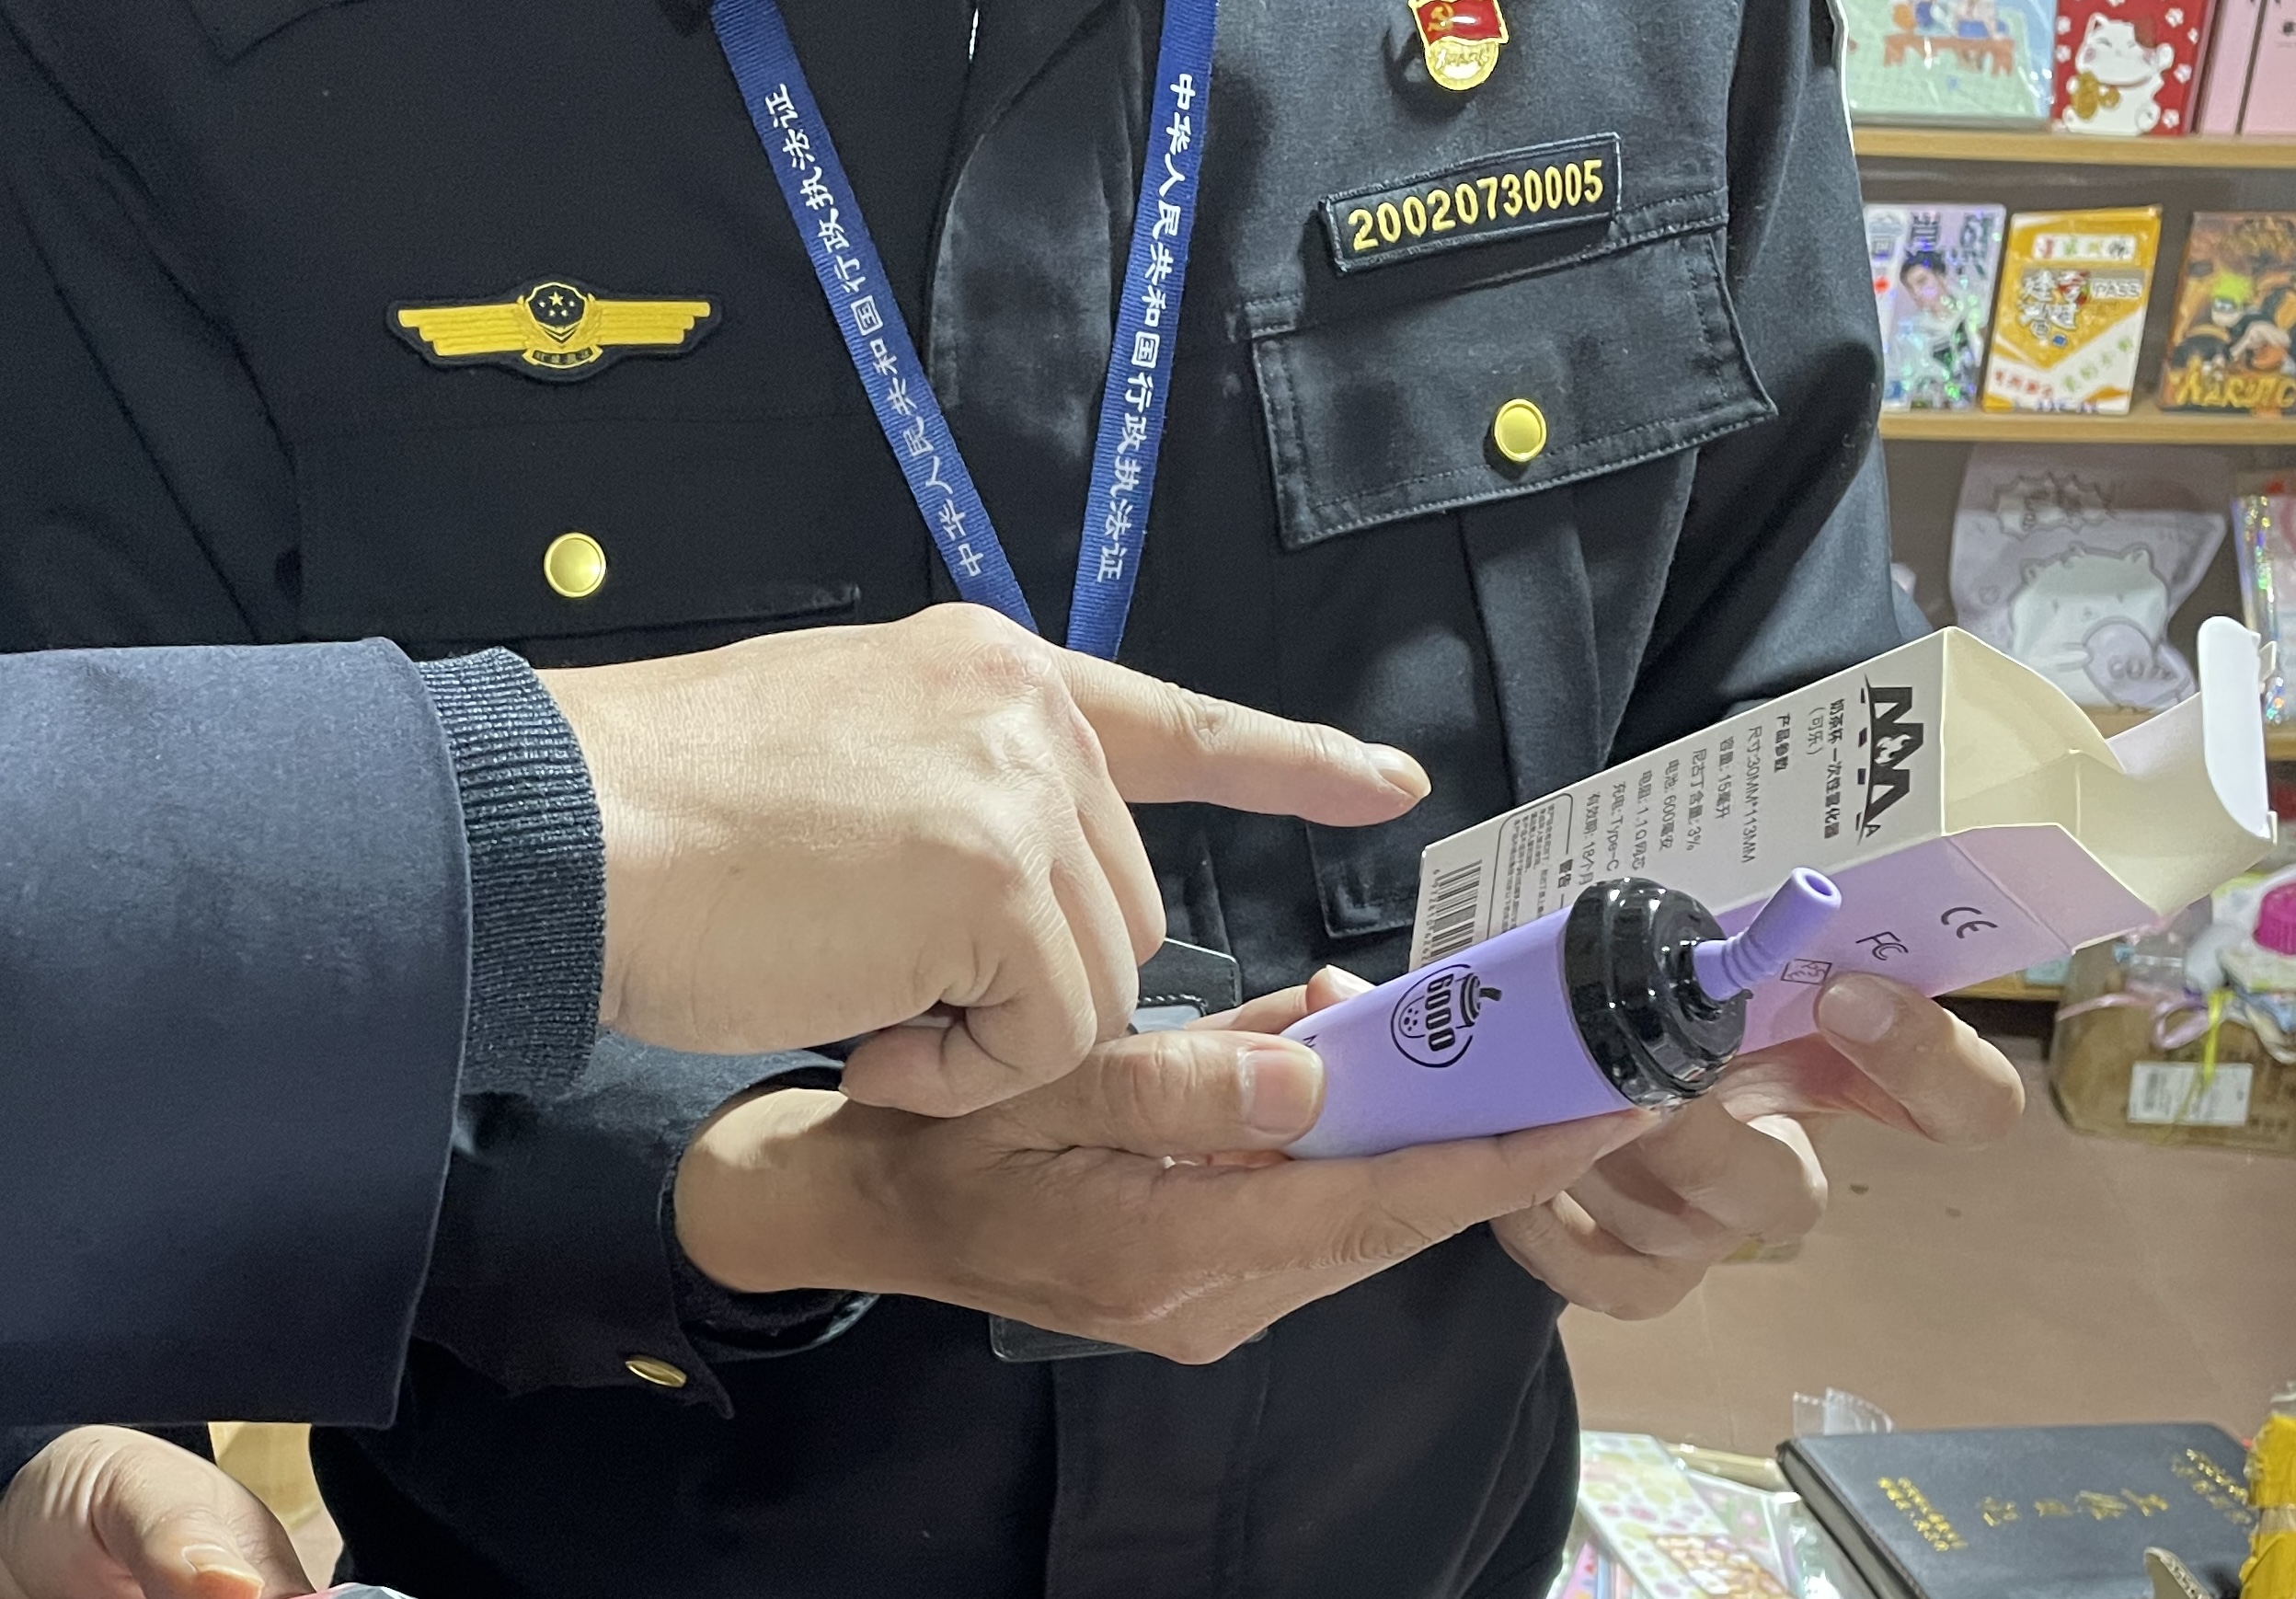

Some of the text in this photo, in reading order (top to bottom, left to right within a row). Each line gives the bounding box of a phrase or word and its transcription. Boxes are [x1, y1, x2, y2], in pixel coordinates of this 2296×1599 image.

[1348, 159, 1604, 251] 20020730005
[764, 83, 984, 577] 中华人民共和国行政执法证
[1096, 73, 1195, 583] 中华人民共和国行政执法证
[1774, 712, 1791, 773] 产品参数
[1557, 858, 1573, 888] 警告
[1941, 906, 1998, 938] CE
[1425, 973, 1455, 1052] 6000
